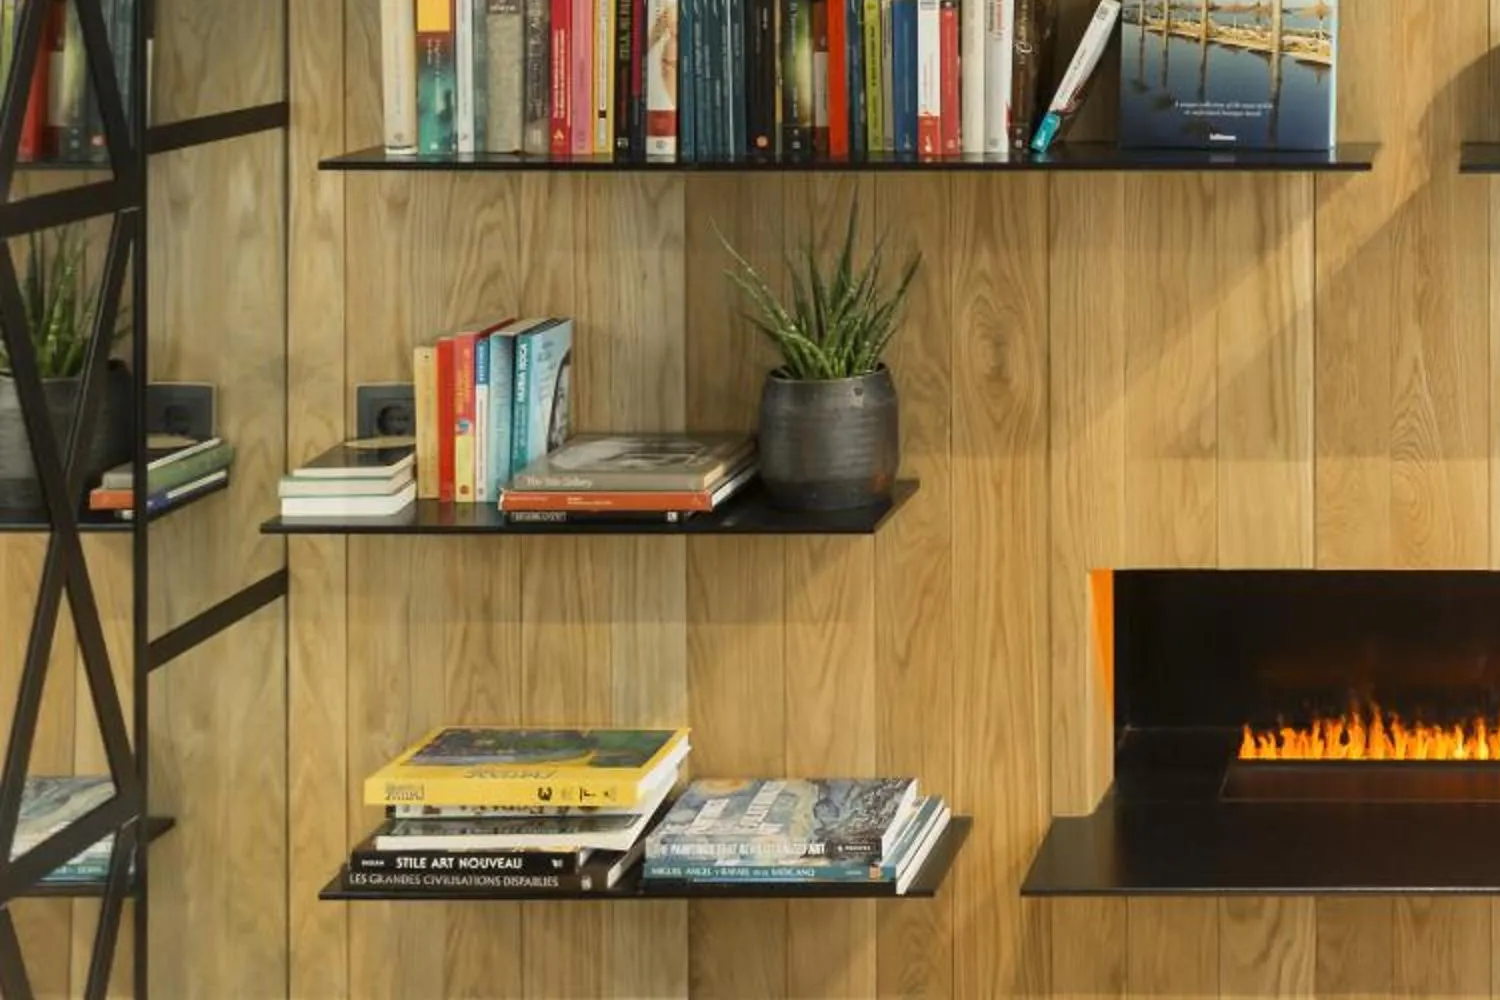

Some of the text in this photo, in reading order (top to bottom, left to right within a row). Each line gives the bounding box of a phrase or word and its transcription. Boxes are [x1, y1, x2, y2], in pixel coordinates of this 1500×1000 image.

[808, 843, 825, 855] ART
[395, 857, 427, 870] STILE
[432, 857, 454, 870] ART
[459, 857, 523, 870] NOUVEAU
[349, 873, 367, 885] LES
[369, 874, 421, 886] GRANDES
